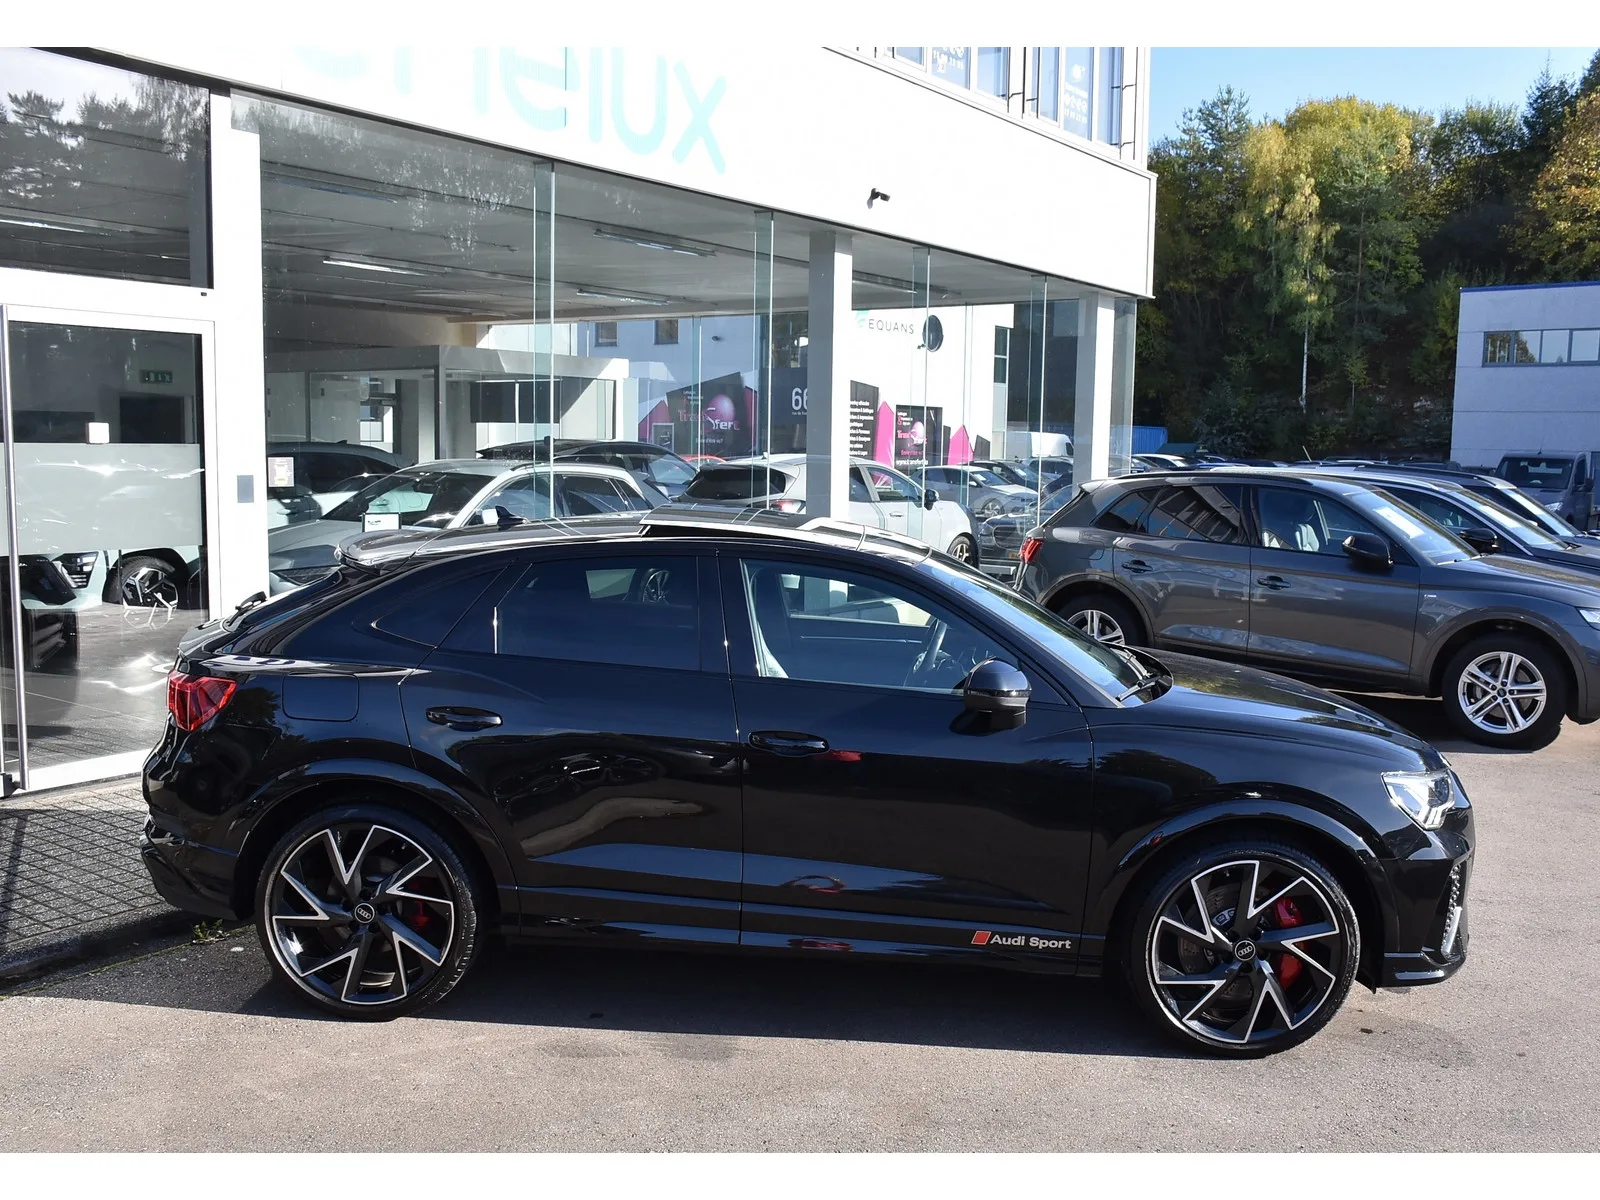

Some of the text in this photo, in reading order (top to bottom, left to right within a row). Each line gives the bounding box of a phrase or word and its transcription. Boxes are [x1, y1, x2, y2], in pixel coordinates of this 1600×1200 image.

[293, 47, 728, 174] elux
[868, 318, 914, 335] EQUANS
[990, 934, 1072, 949] Audi Sport
